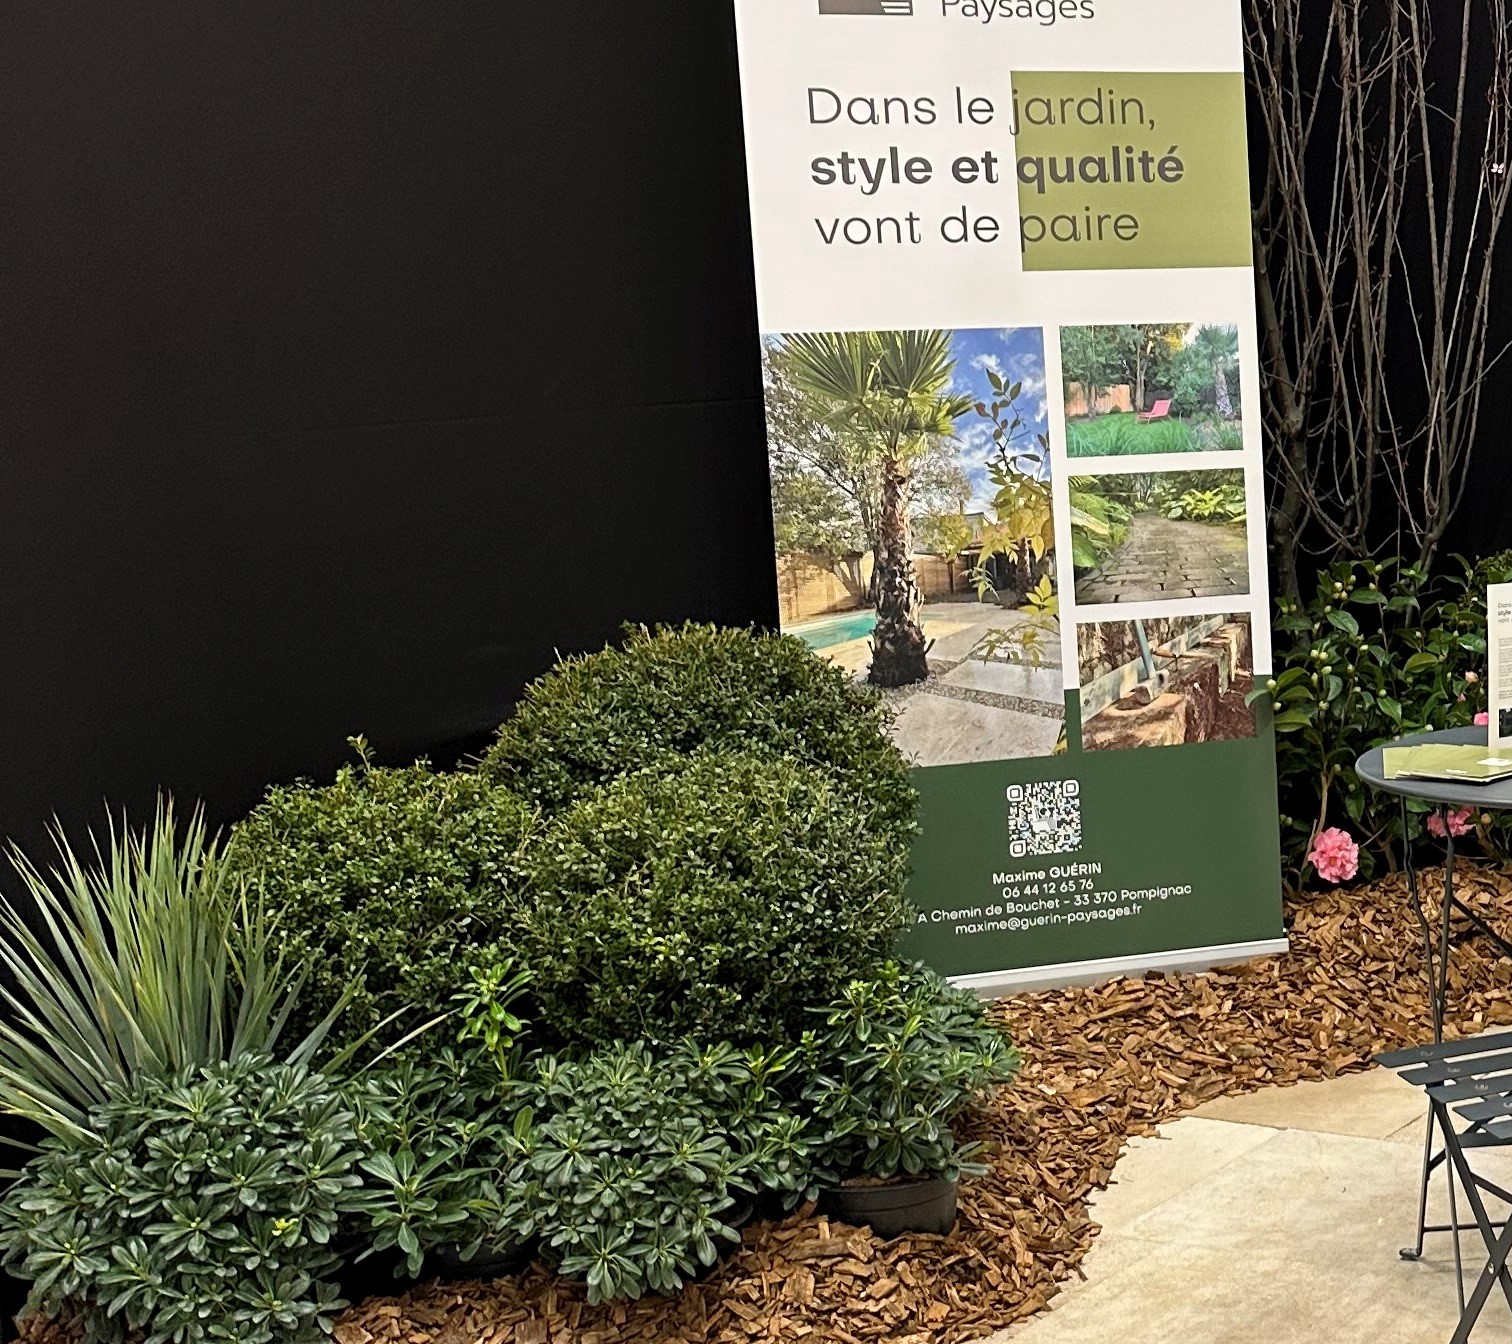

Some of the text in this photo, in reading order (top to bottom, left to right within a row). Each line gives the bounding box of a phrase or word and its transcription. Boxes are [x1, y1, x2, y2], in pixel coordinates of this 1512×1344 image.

[807, 86, 1156, 135] Dans le jardin,
[811, 145, 1184, 195] style et qualité
[814, 206, 1139, 253] vont de paire
[992, 862, 1103, 885] Maxime GUÉRIN
[1002, 878, 1095, 899] 06 44 12 65 76
[931, 906, 982, 923] Chemin
[985, 903, 1003, 917] de
[1006, 897, 1060, 915] Bouchet
[1073, 893, 1090, 907] 33
[1093, 890, 1117, 905] 370
[1121, 883, 1192, 903] Pompignac
